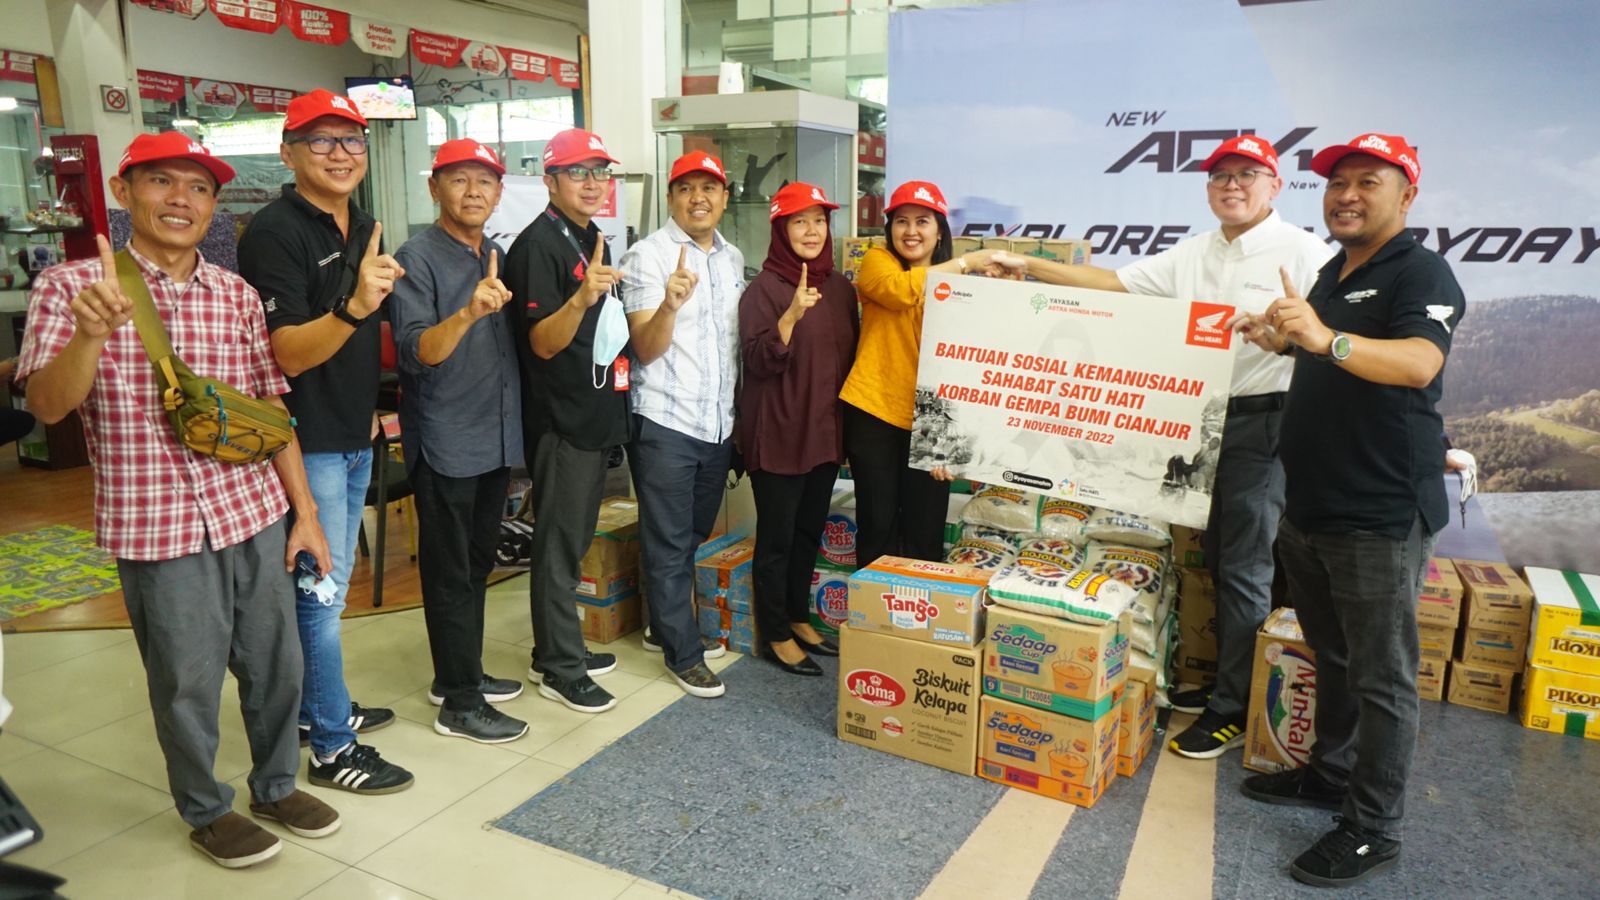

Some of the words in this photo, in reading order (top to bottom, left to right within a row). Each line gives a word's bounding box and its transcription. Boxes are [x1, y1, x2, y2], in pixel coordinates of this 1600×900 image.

[301, 9, 329, 21] 100%
[304, 28, 331, 36] Honda
[368, 23, 393, 35] Honda
[366, 32, 396, 44] Genuine
[370, 41, 393, 52] Parts
[1105, 110, 1167, 127] NEW
[1289, 180, 1320, 191] New
[1049, 298, 1080, 308] YAYASAN
[1048, 305, 1068, 313] ASTRA
[1068, 308, 1090, 316] HONDA
[1089, 310, 1113, 320] MOTOR
[935, 342, 1008, 367] BANTUAN
[1012, 353, 1068, 376] SOSIAL
[1073, 362, 1204, 398] KEMANUSIAAN
[981, 370, 1056, 396] SAHABAT
[1058, 382, 1102, 403] SATU
[1104, 390, 1145, 410] HATI
[937, 383, 1002, 408] KORBAN
[1005, 394, 1061, 418] GEMPA
[1065, 404, 1111, 426] BUMI
[1113, 412, 1192, 441] CIANJUR
[1007, 416, 1021, 428] 23
[1023, 419, 1083, 439] NOVEMBER
[1085, 431, 1114, 445] 2022
[824, 521, 848, 536] POP
[829, 532, 854, 545] MIE
[1019, 550, 1076, 573] ROJOLELE
[824, 586, 848, 600] POP
[881, 593, 939, 622] Tango
[997, 623, 1011, 631] Mie
[990, 630, 1057, 656] Sedaap
[954, 657, 974, 666] PACK
[854, 678, 897, 701] Roma
[912, 668, 972, 696] Biskuit
[987, 681, 995, 692] 9
[913, 687, 968, 716] Kelapa
[1548, 688, 1600, 708] PIKOP
[912, 708, 942, 720] COCONUT
[943, 715, 967, 727] BISCUIT
[994, 711, 1009, 719] Mie
[988, 717, 1053, 744] Sedaap
